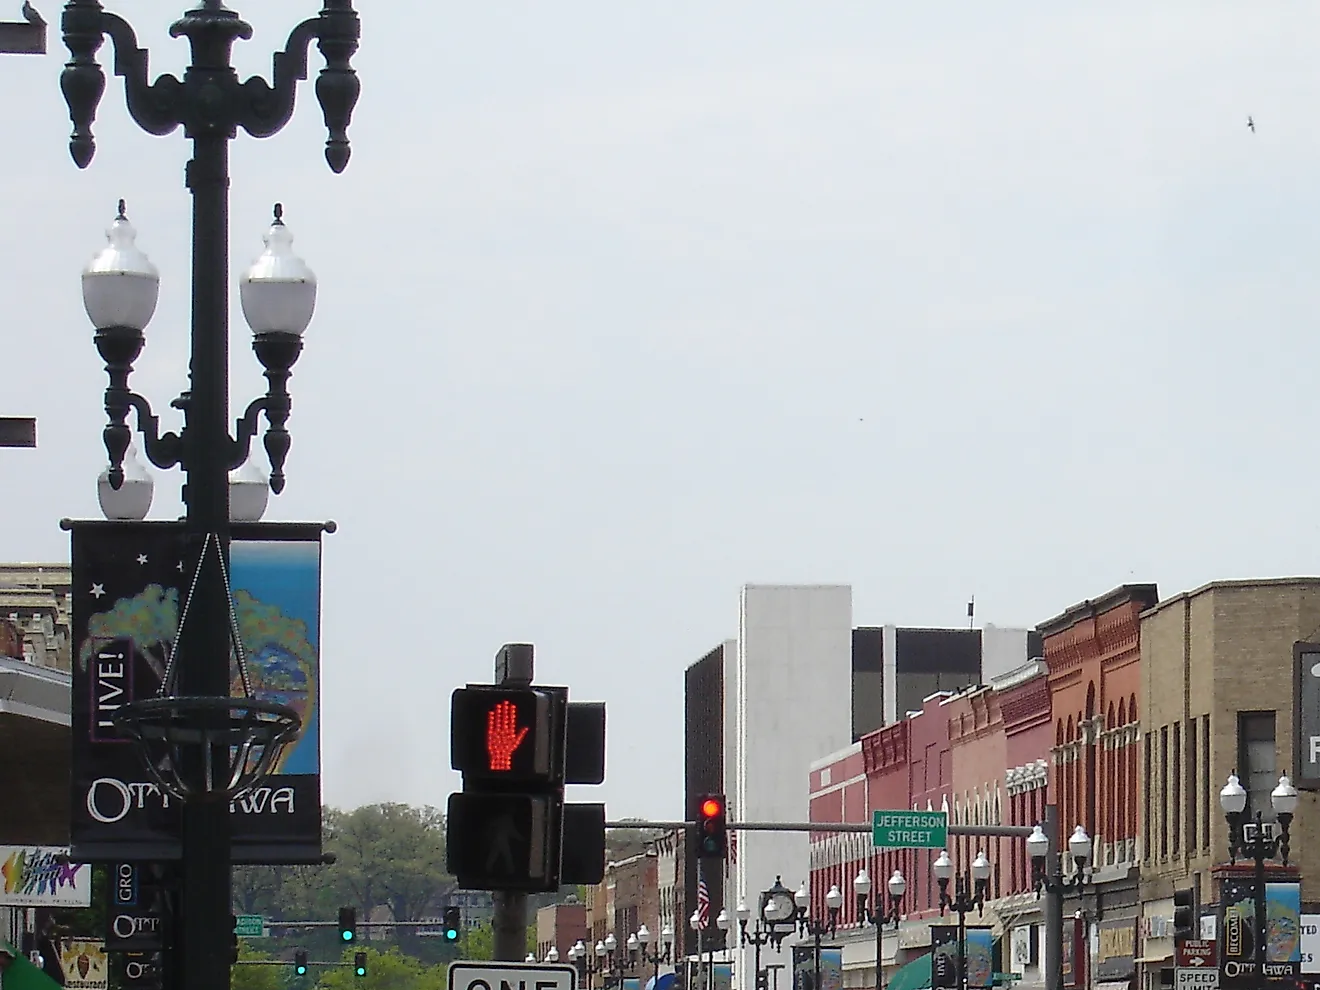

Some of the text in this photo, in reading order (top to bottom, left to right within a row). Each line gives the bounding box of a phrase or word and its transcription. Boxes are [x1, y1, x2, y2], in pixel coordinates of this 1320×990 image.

[876, 815, 945, 828] JEFFERSON
[887, 830, 932, 843] STREET
[1185, 940, 1210, 948] PUBLIC
[1183, 948, 1212, 956] PARKING
[1180, 973, 1217, 983] SPEED
